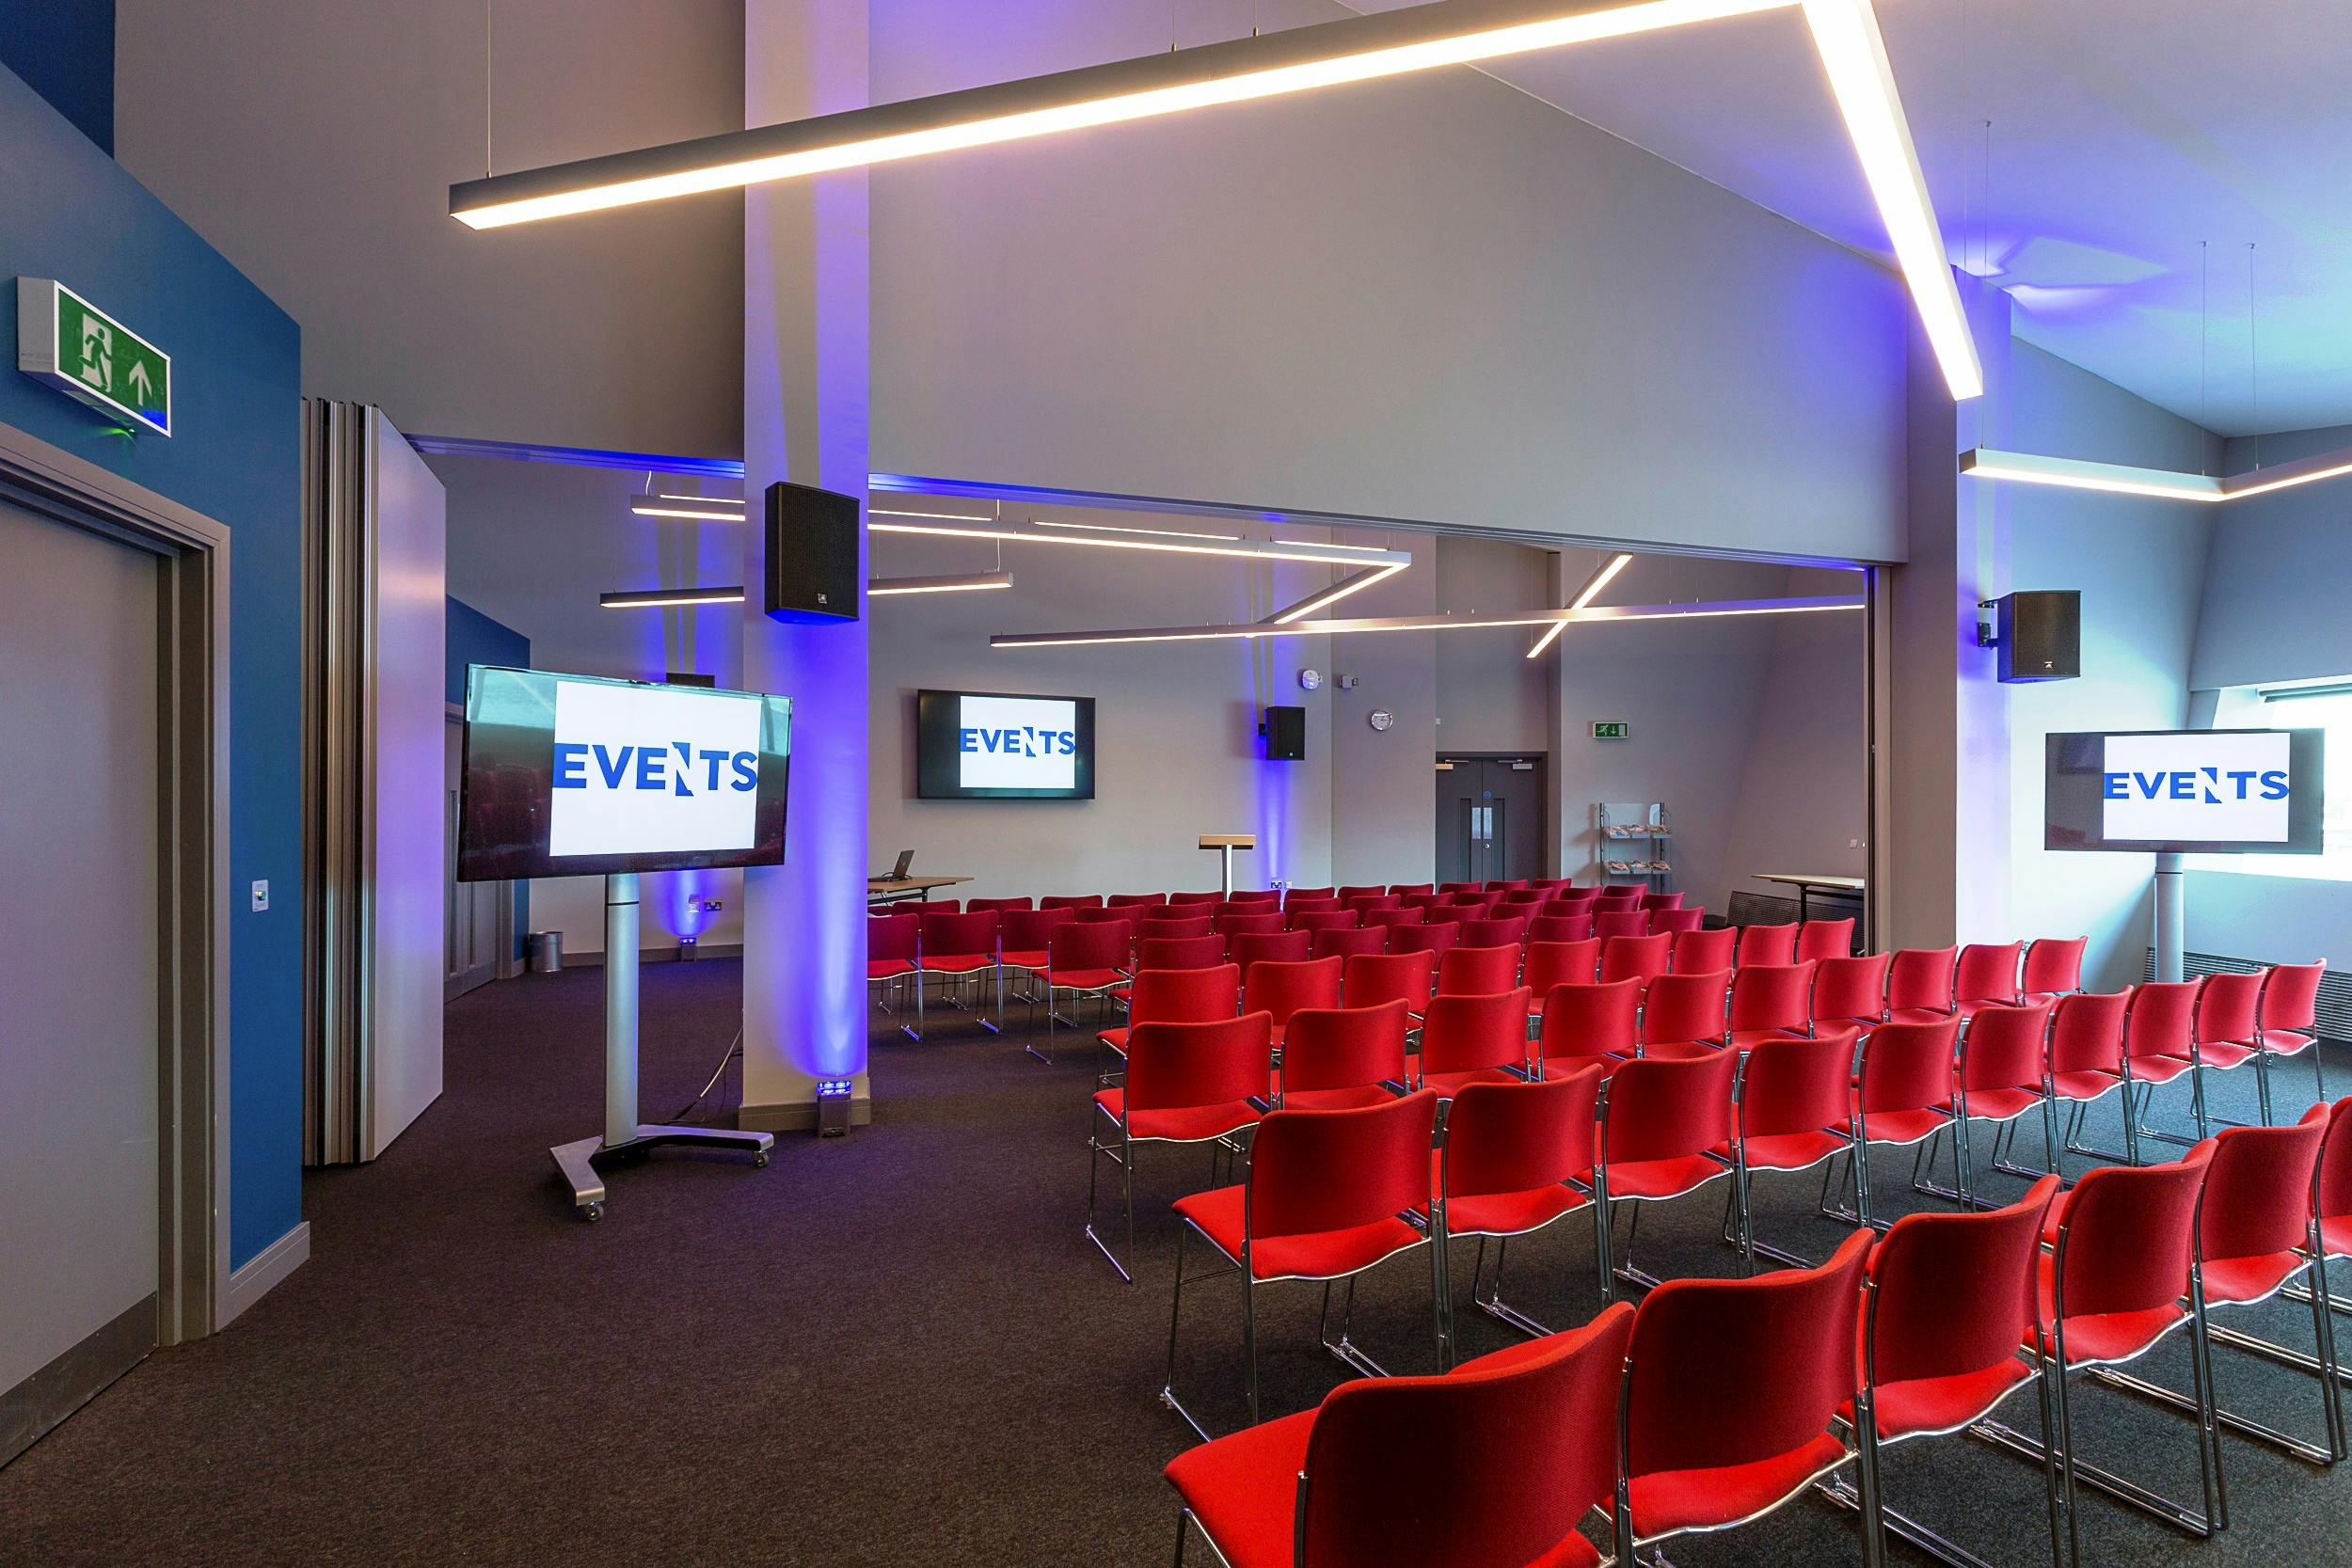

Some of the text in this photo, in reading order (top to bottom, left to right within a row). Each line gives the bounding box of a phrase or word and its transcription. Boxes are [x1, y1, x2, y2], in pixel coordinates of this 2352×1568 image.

[961, 727, 1075, 757] EVENTS
[552, 742, 757, 796] EVENTS
[2103, 768, 2289, 803] EVENTS
